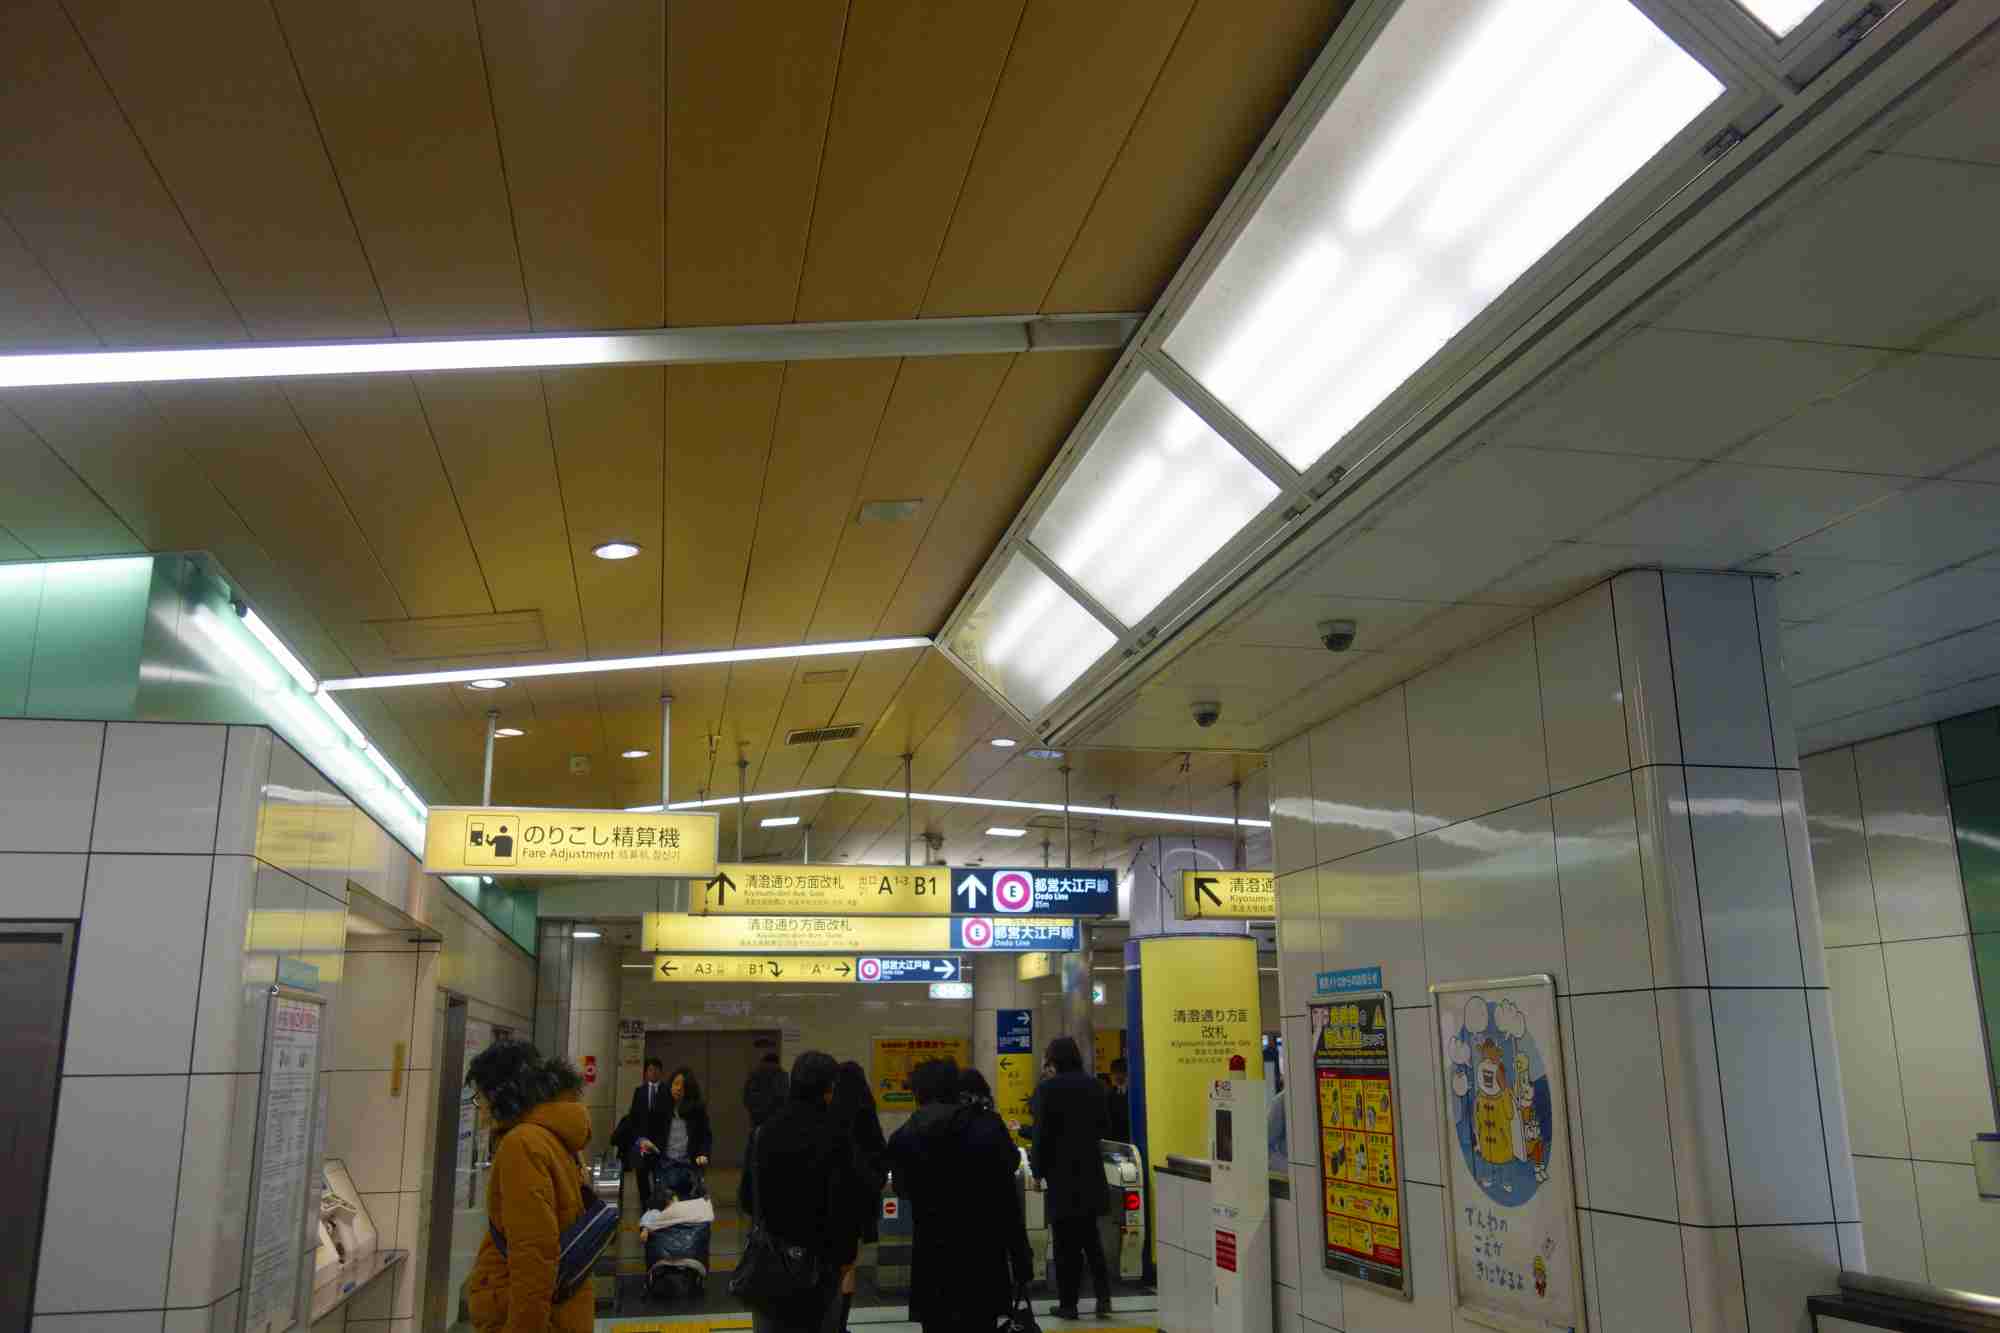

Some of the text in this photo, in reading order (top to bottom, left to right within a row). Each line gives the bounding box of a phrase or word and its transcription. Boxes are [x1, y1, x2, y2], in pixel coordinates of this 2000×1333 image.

[524, 825, 680, 848] のりこし精算機
[522, 848, 614, 861] Fare Adjustment
[744, 874, 844, 890] 清澄通り方面改札
[914, 876, 937, 895] B1
[1034, 878, 1109, 893] 都営大江戸線
[1009, 886, 1017, 898] E
[994, 926, 1074, 940] 都営大江戸線
[695, 963, 713, 975] A3
[749, 963, 764, 975] B1
